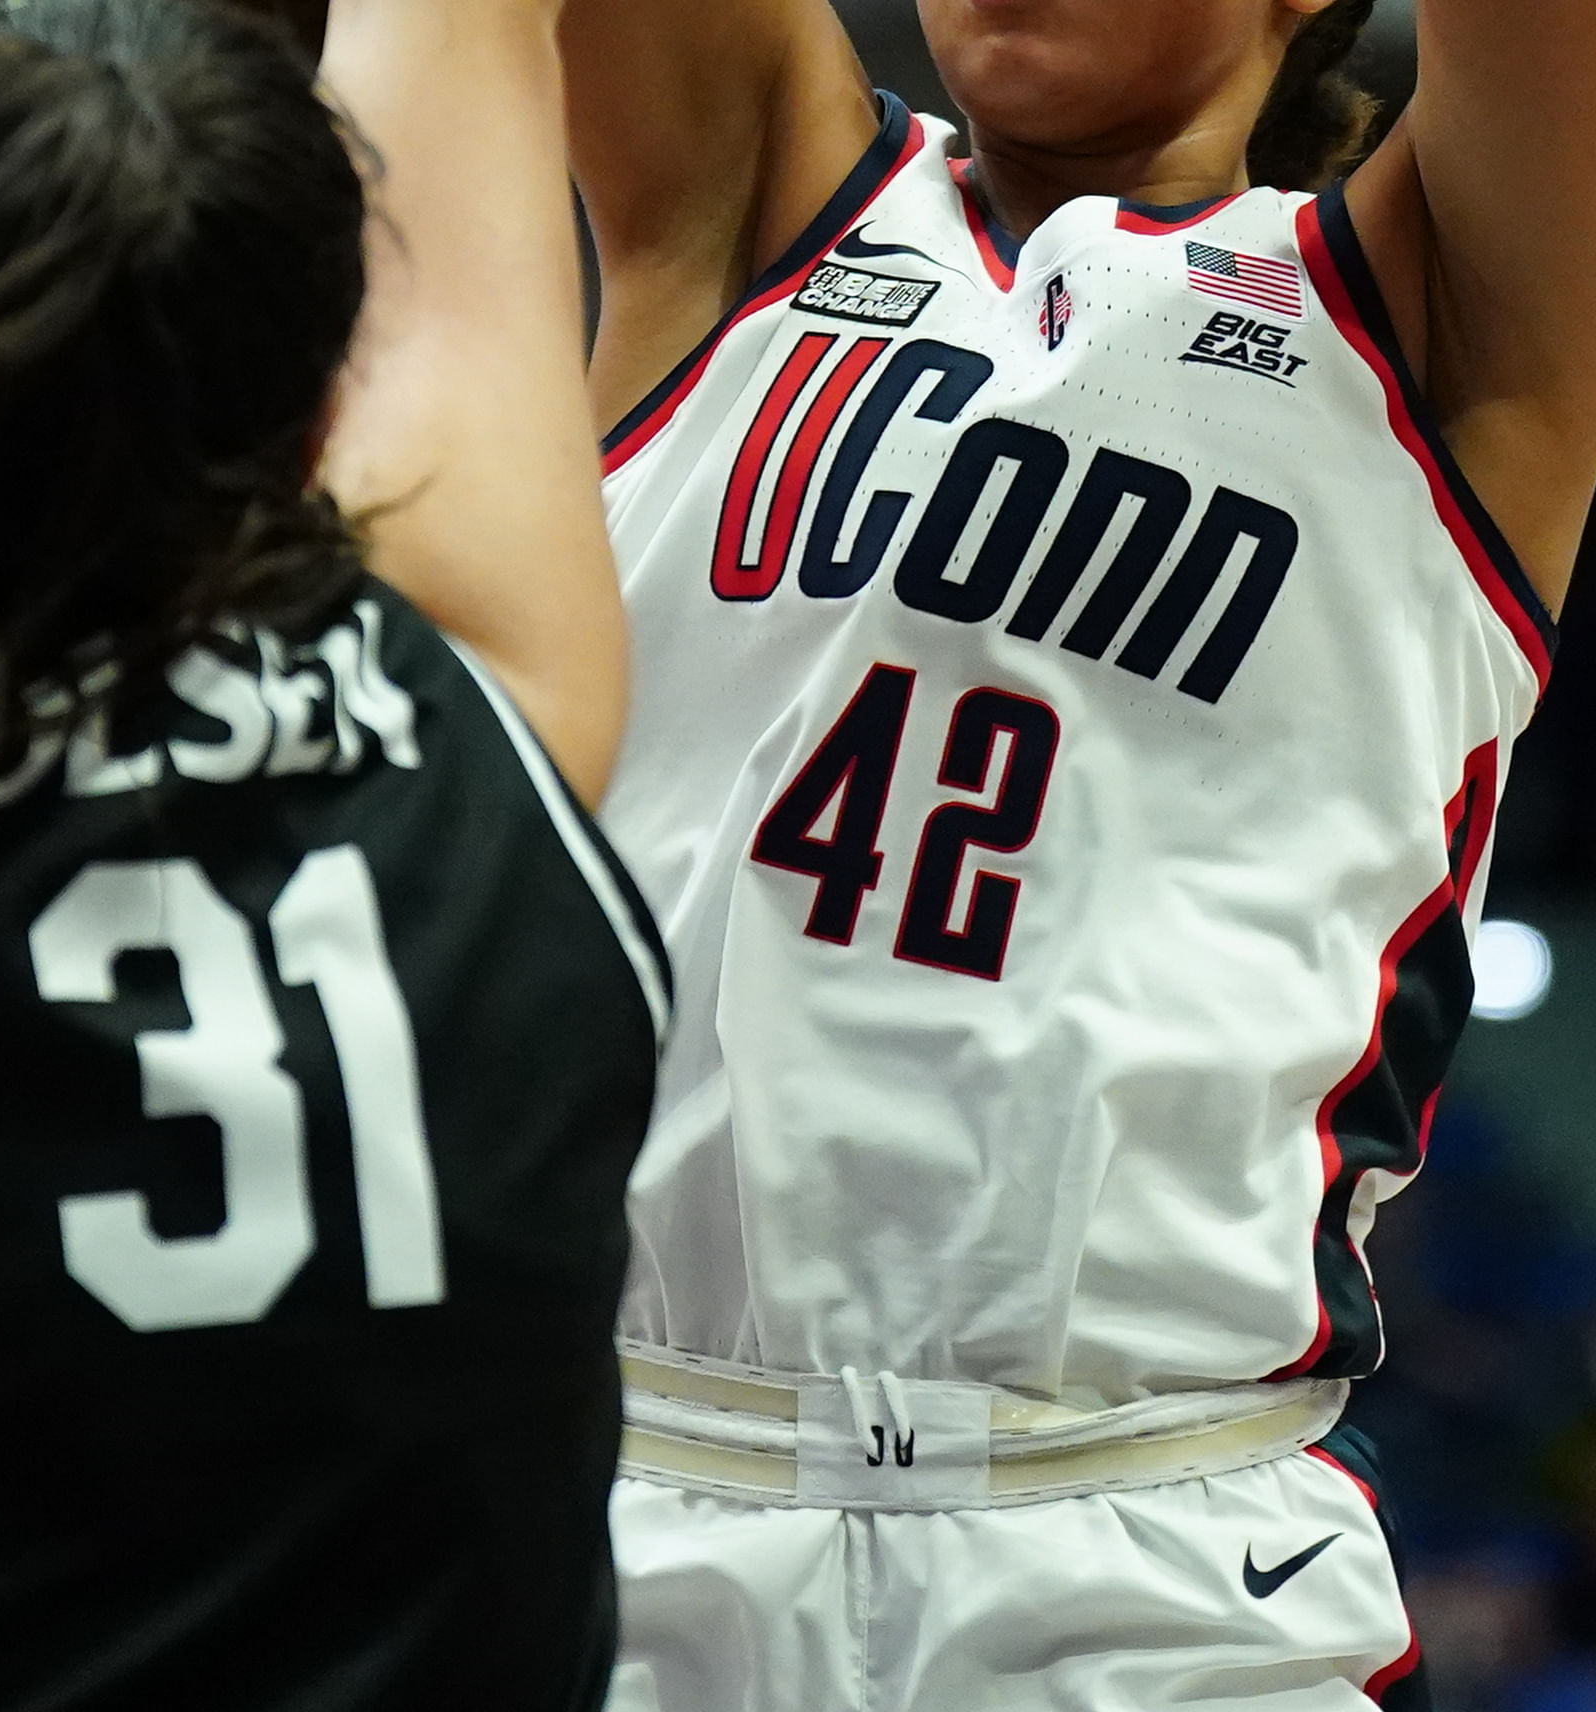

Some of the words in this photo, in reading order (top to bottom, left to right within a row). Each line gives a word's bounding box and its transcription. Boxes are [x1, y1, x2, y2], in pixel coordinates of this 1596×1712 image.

[797, 288, 919, 321] CHANGE
[1203, 310, 1292, 349] BIG
[1189, 332, 1310, 377] EAST
[750, 662, 1062, 983] 42
[28, 841, 447, 1334] 31
